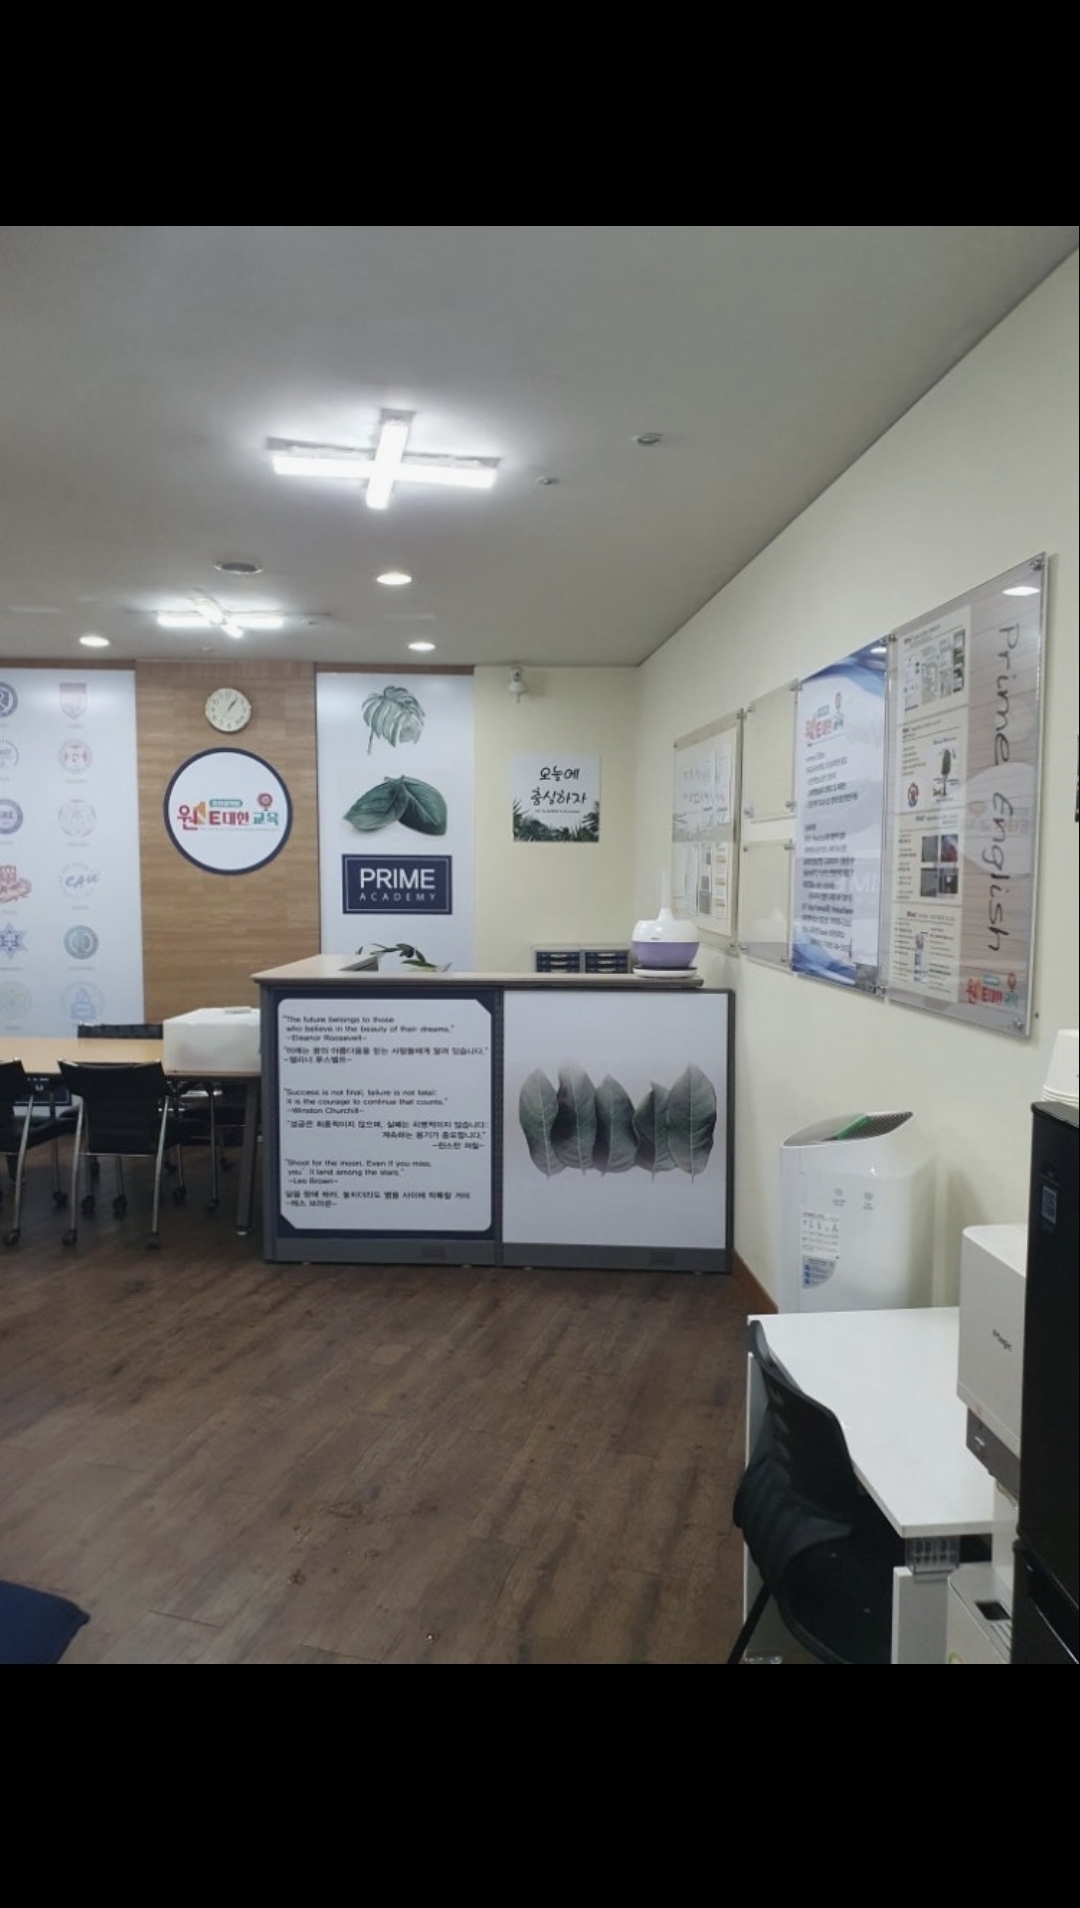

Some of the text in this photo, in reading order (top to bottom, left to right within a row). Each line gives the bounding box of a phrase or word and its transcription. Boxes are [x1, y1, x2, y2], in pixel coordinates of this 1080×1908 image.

[995, 623, 1019, 766] Prime
[539, 764, 580, 782] 오늘에
[530, 786, 587, 806] 충실하자
[252, 811, 279, 827] 교육
[981, 792, 1014, 952] English
[360, 867, 436, 889] PRIME
[359, 892, 436, 902] ACADEMY
[303, 1016, 326, 1024] future
[327, 1016, 361, 1024] belongs
[372, 1016, 395, 1024] those
[304, 1025, 333, 1033] believe
[360, 1025, 388, 1033] beauty
[400, 1025, 418, 1033] their
[367, 1088, 392, 1097] failure
[317, 1098, 351, 1106] courage
[363, 1098, 397, 1106] continue
[399, 1098, 415, 1106] that
[365, 1159, 387, 1168] Even
[316, 1168, 333, 1177] land
[335, 1168, 363, 1177] among
